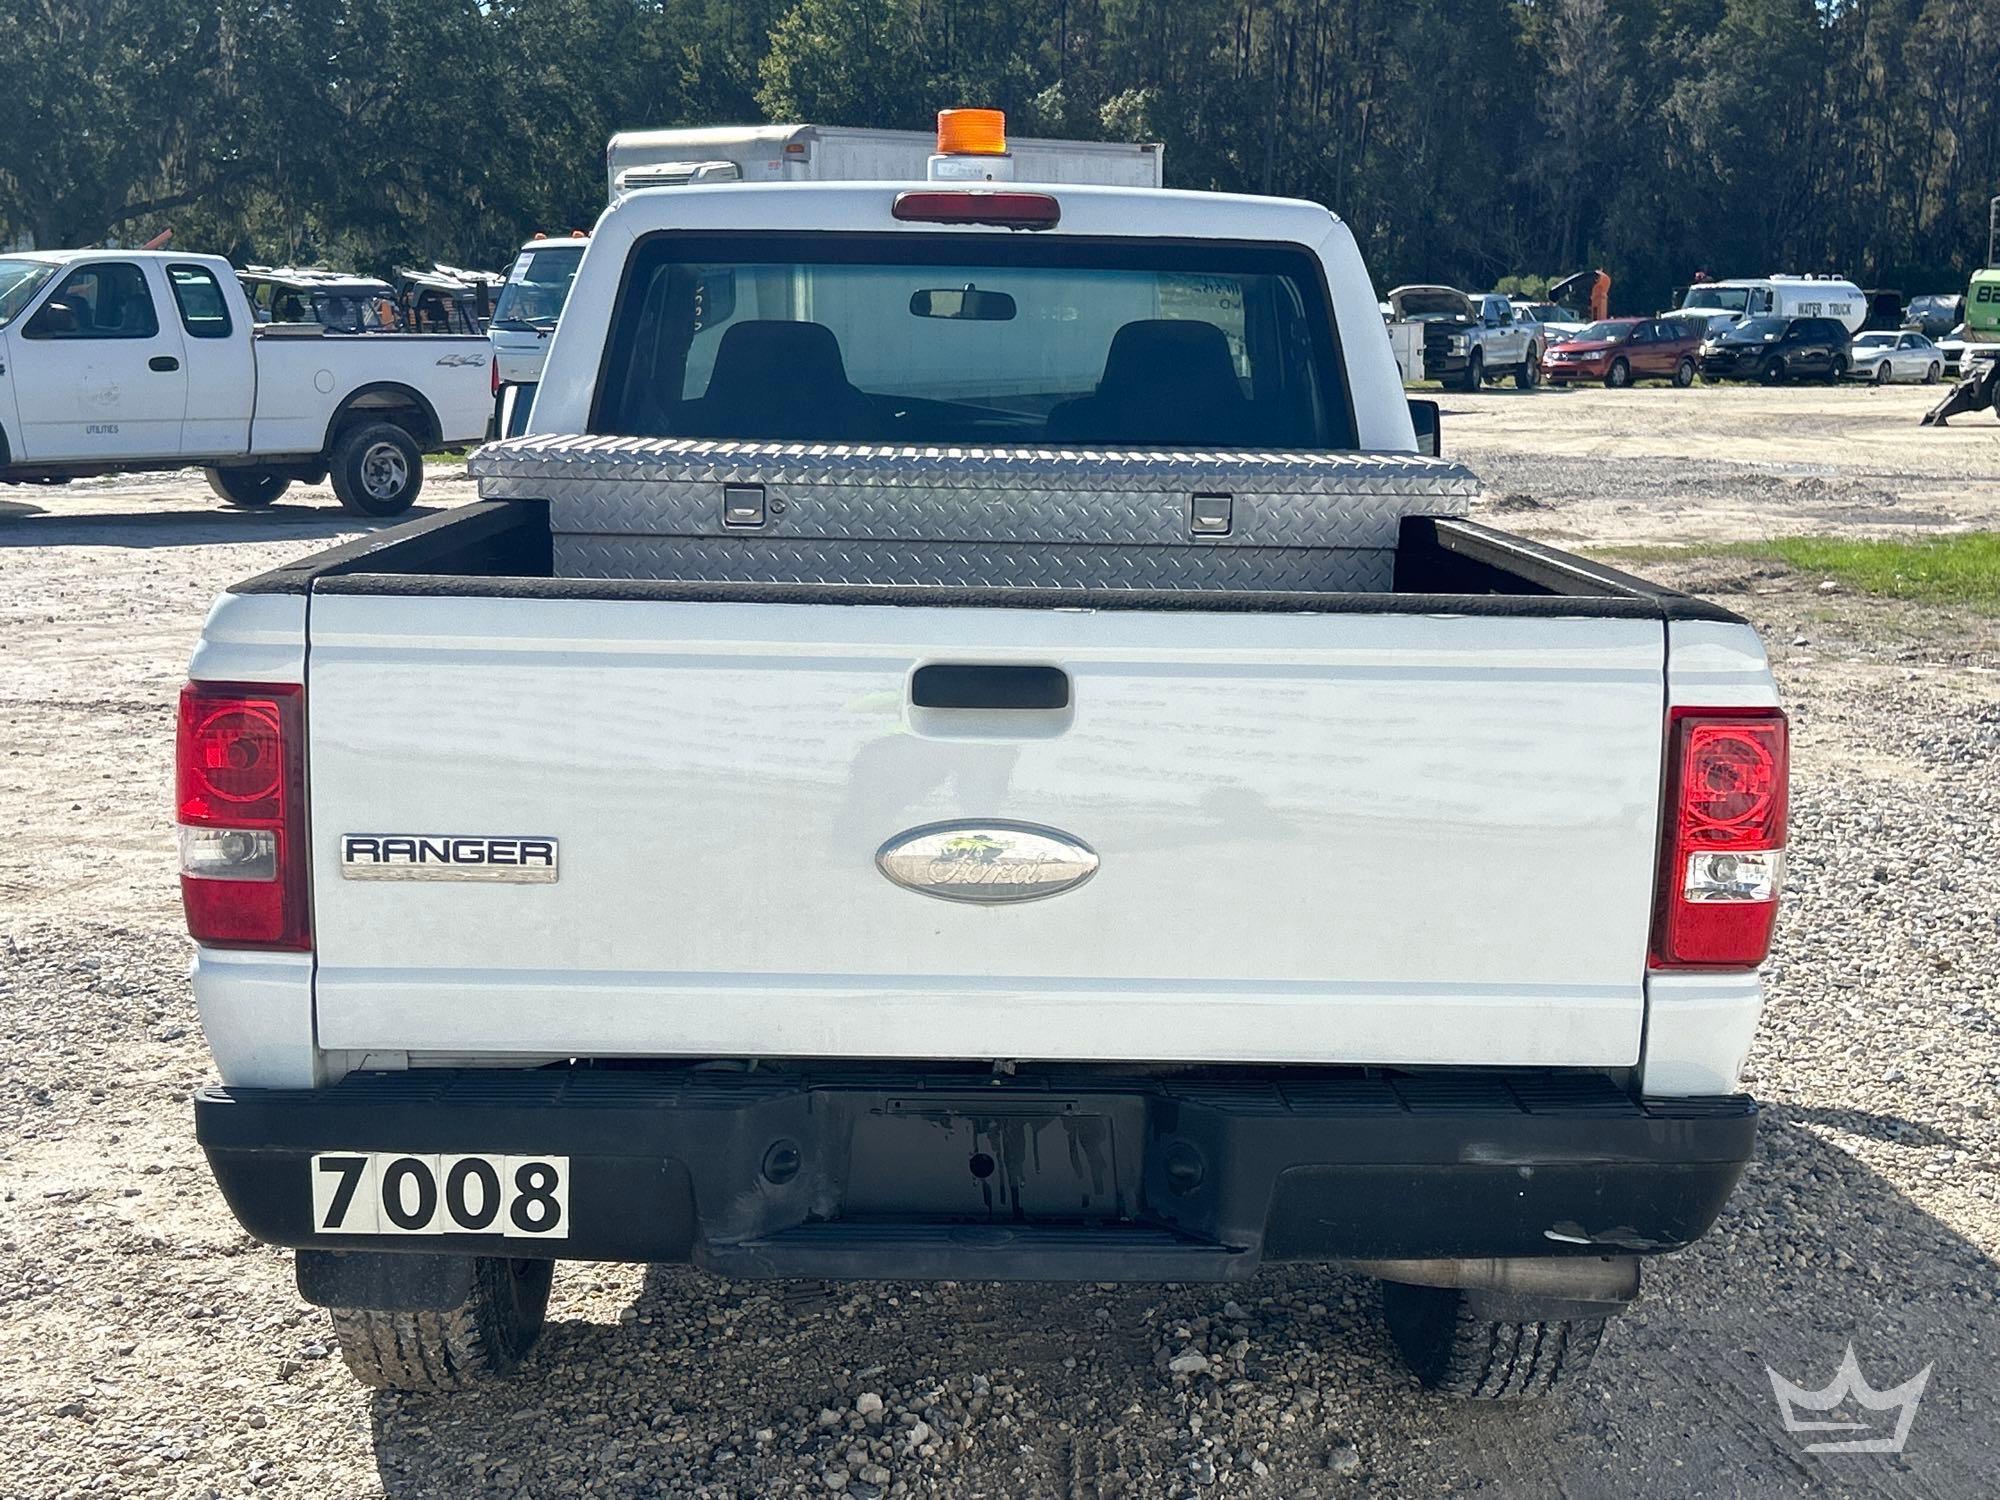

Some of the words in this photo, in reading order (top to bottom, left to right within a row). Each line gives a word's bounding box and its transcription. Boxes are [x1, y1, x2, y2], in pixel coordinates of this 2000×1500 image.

[1797, 302, 1822, 316] WATER
[1829, 303, 1852, 316] TRUCK
[86, 424, 119, 434] UTILITIES
[345, 838, 553, 866] RANGER
[927, 852, 1045, 885] Ford
[319, 1156, 561, 1233] 7008
